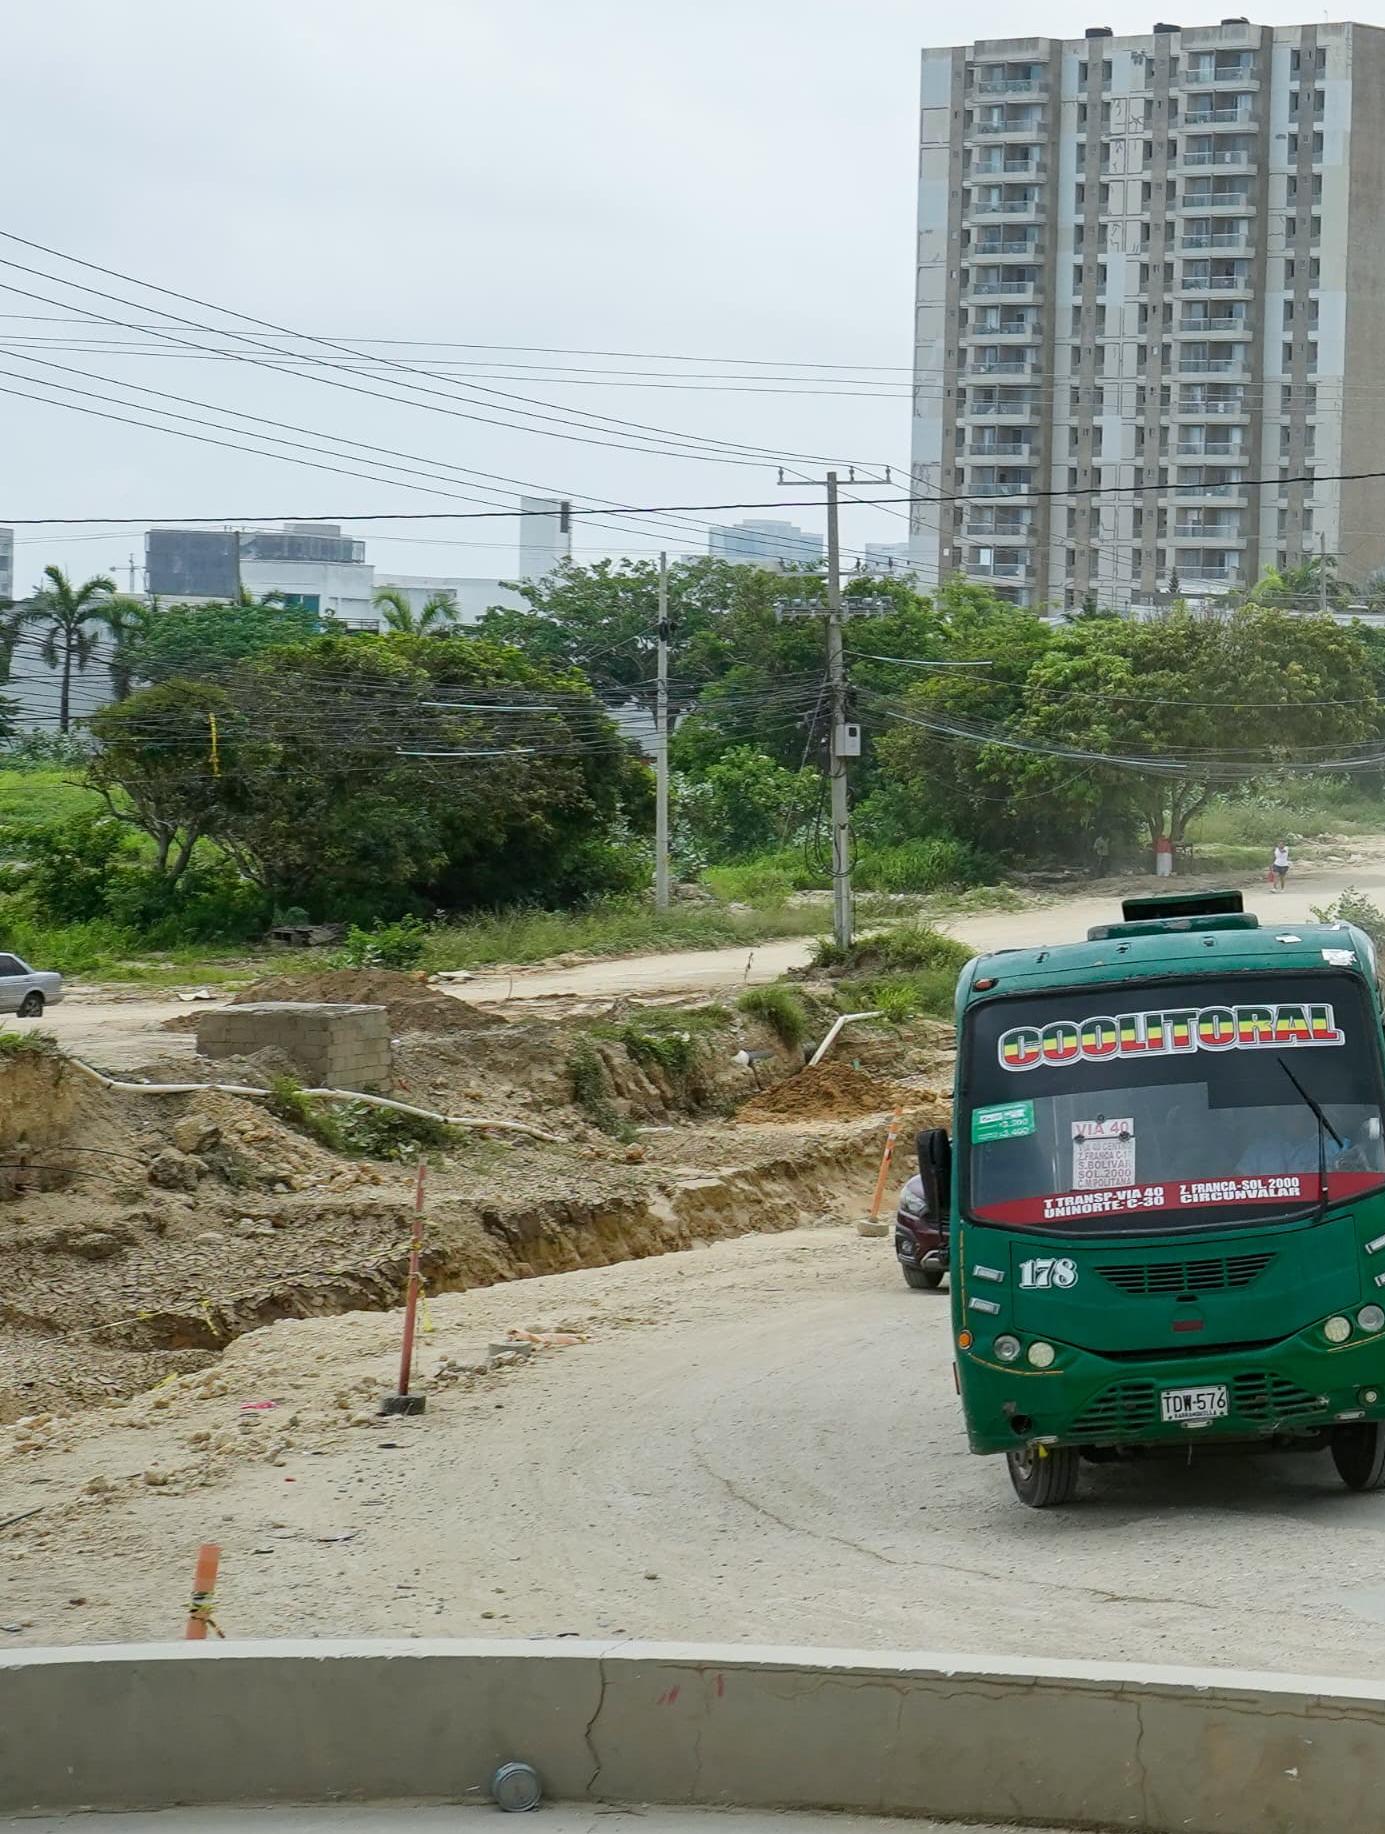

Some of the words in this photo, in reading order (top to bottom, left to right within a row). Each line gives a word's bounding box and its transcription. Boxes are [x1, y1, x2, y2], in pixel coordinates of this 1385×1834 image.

[998, 1003, 1346, 1072] COOLITORAL
[1075, 1123, 1105, 1136] VIA
[1110, 1121, 1129, 1134] 40
[1269, 1177, 1300, 1189] 2000
[1144, 1186, 1164, 1197] 40
[1180, 1187, 1301, 1204] CIRCUNVALAR
[1127, 1196, 1165, 1209] C-30
[1018, 1257, 1079, 1289] 178
[1163, 1392, 1227, 1413] TDW-576
